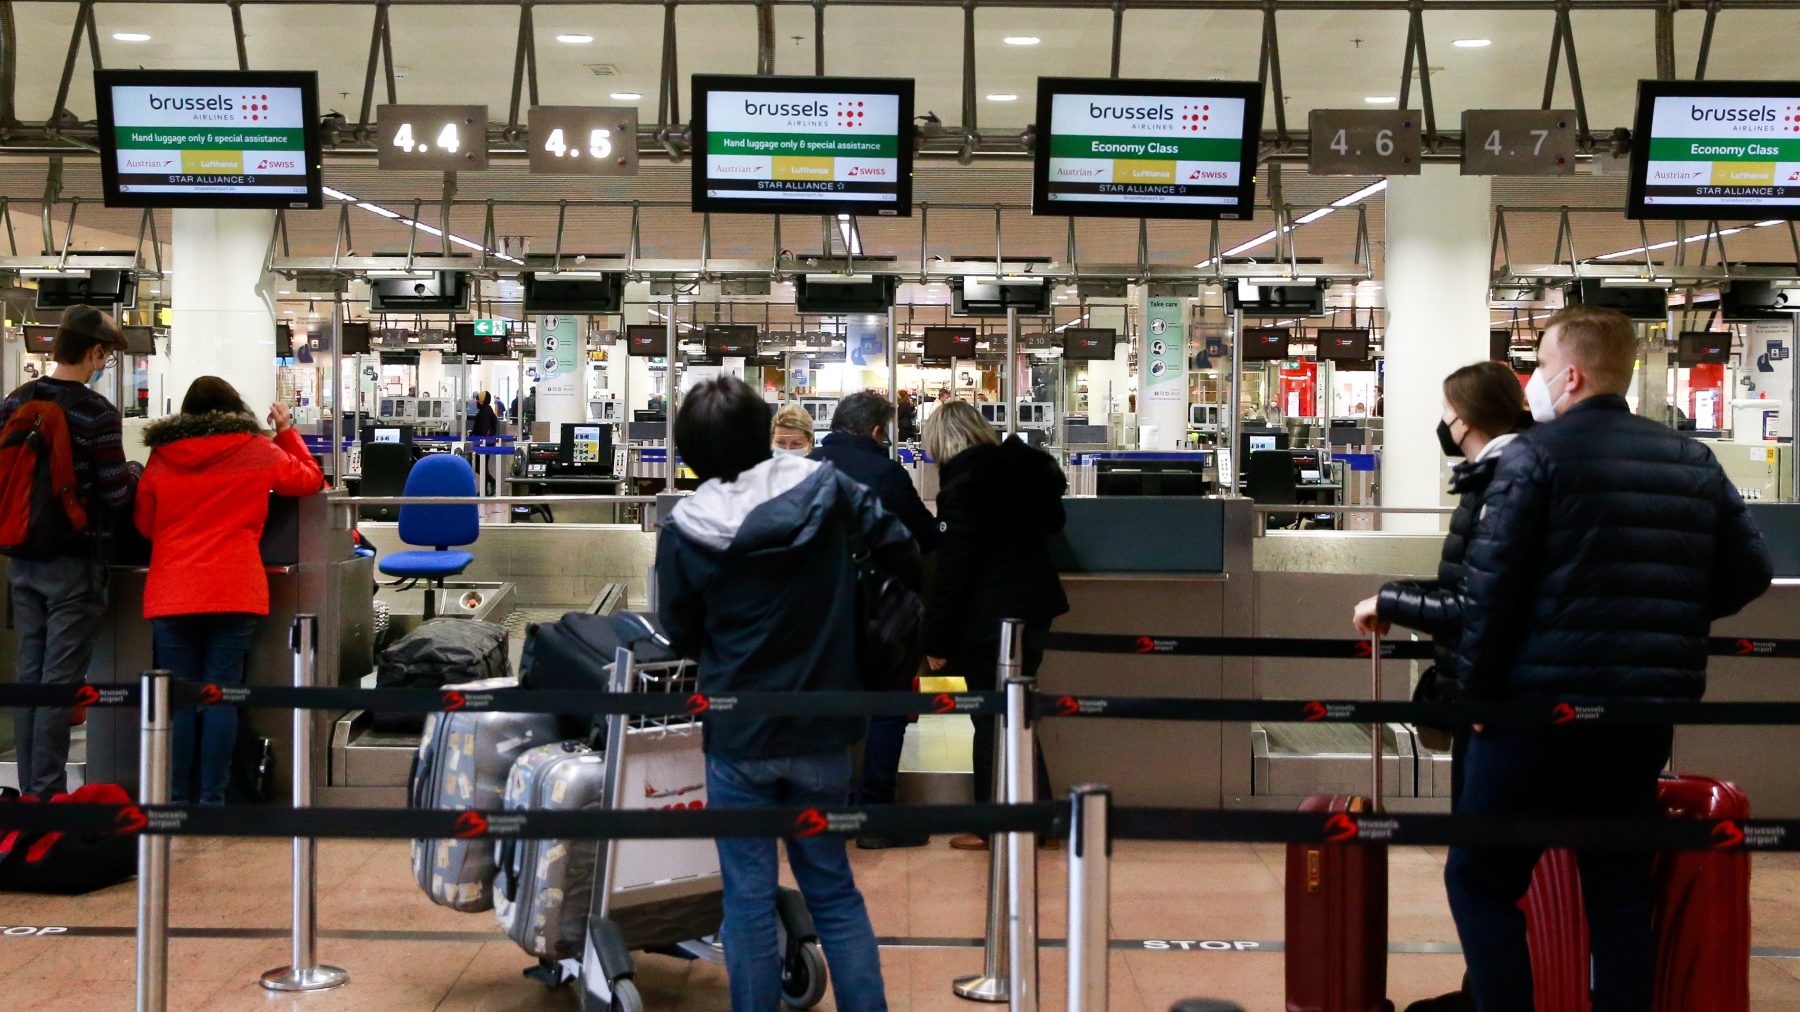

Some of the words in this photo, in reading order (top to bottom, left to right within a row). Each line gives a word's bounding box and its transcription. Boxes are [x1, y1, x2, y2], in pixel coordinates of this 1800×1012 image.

[150, 94, 233, 110] brussels
[746, 100, 828, 116] brussels
[1090, 102, 1174, 120] brussels
[1692, 105, 1776, 122] brussels
[132, 134, 152, 142] Hand
[154, 134, 187, 144] luggage
[188, 134, 206, 144] only
[214, 135, 243, 144] special
[724, 139, 745, 147] Hand
[747, 140, 778, 150] luggage
[780, 140, 798, 150] only
[807, 141, 836, 150] special
[837, 142, 880, 150] assistance
[1092, 141, 1145, 154] Economy
[1147, 142, 1178, 154] Class
[1691, 144, 1745, 157] Economy
[1748, 144, 1779, 155] Class
[716, 164, 750, 172] Austrian
[1057, 168, 1092, 176] Austrian
[786, 182, 834, 190] ALLIANCE
[1127, 186, 1175, 194] ALLIANCE
[1744, 826, 1786, 835] brussels
[1745, 836, 1778, 846] airport
[1143, 940, 1259, 950] STOP
